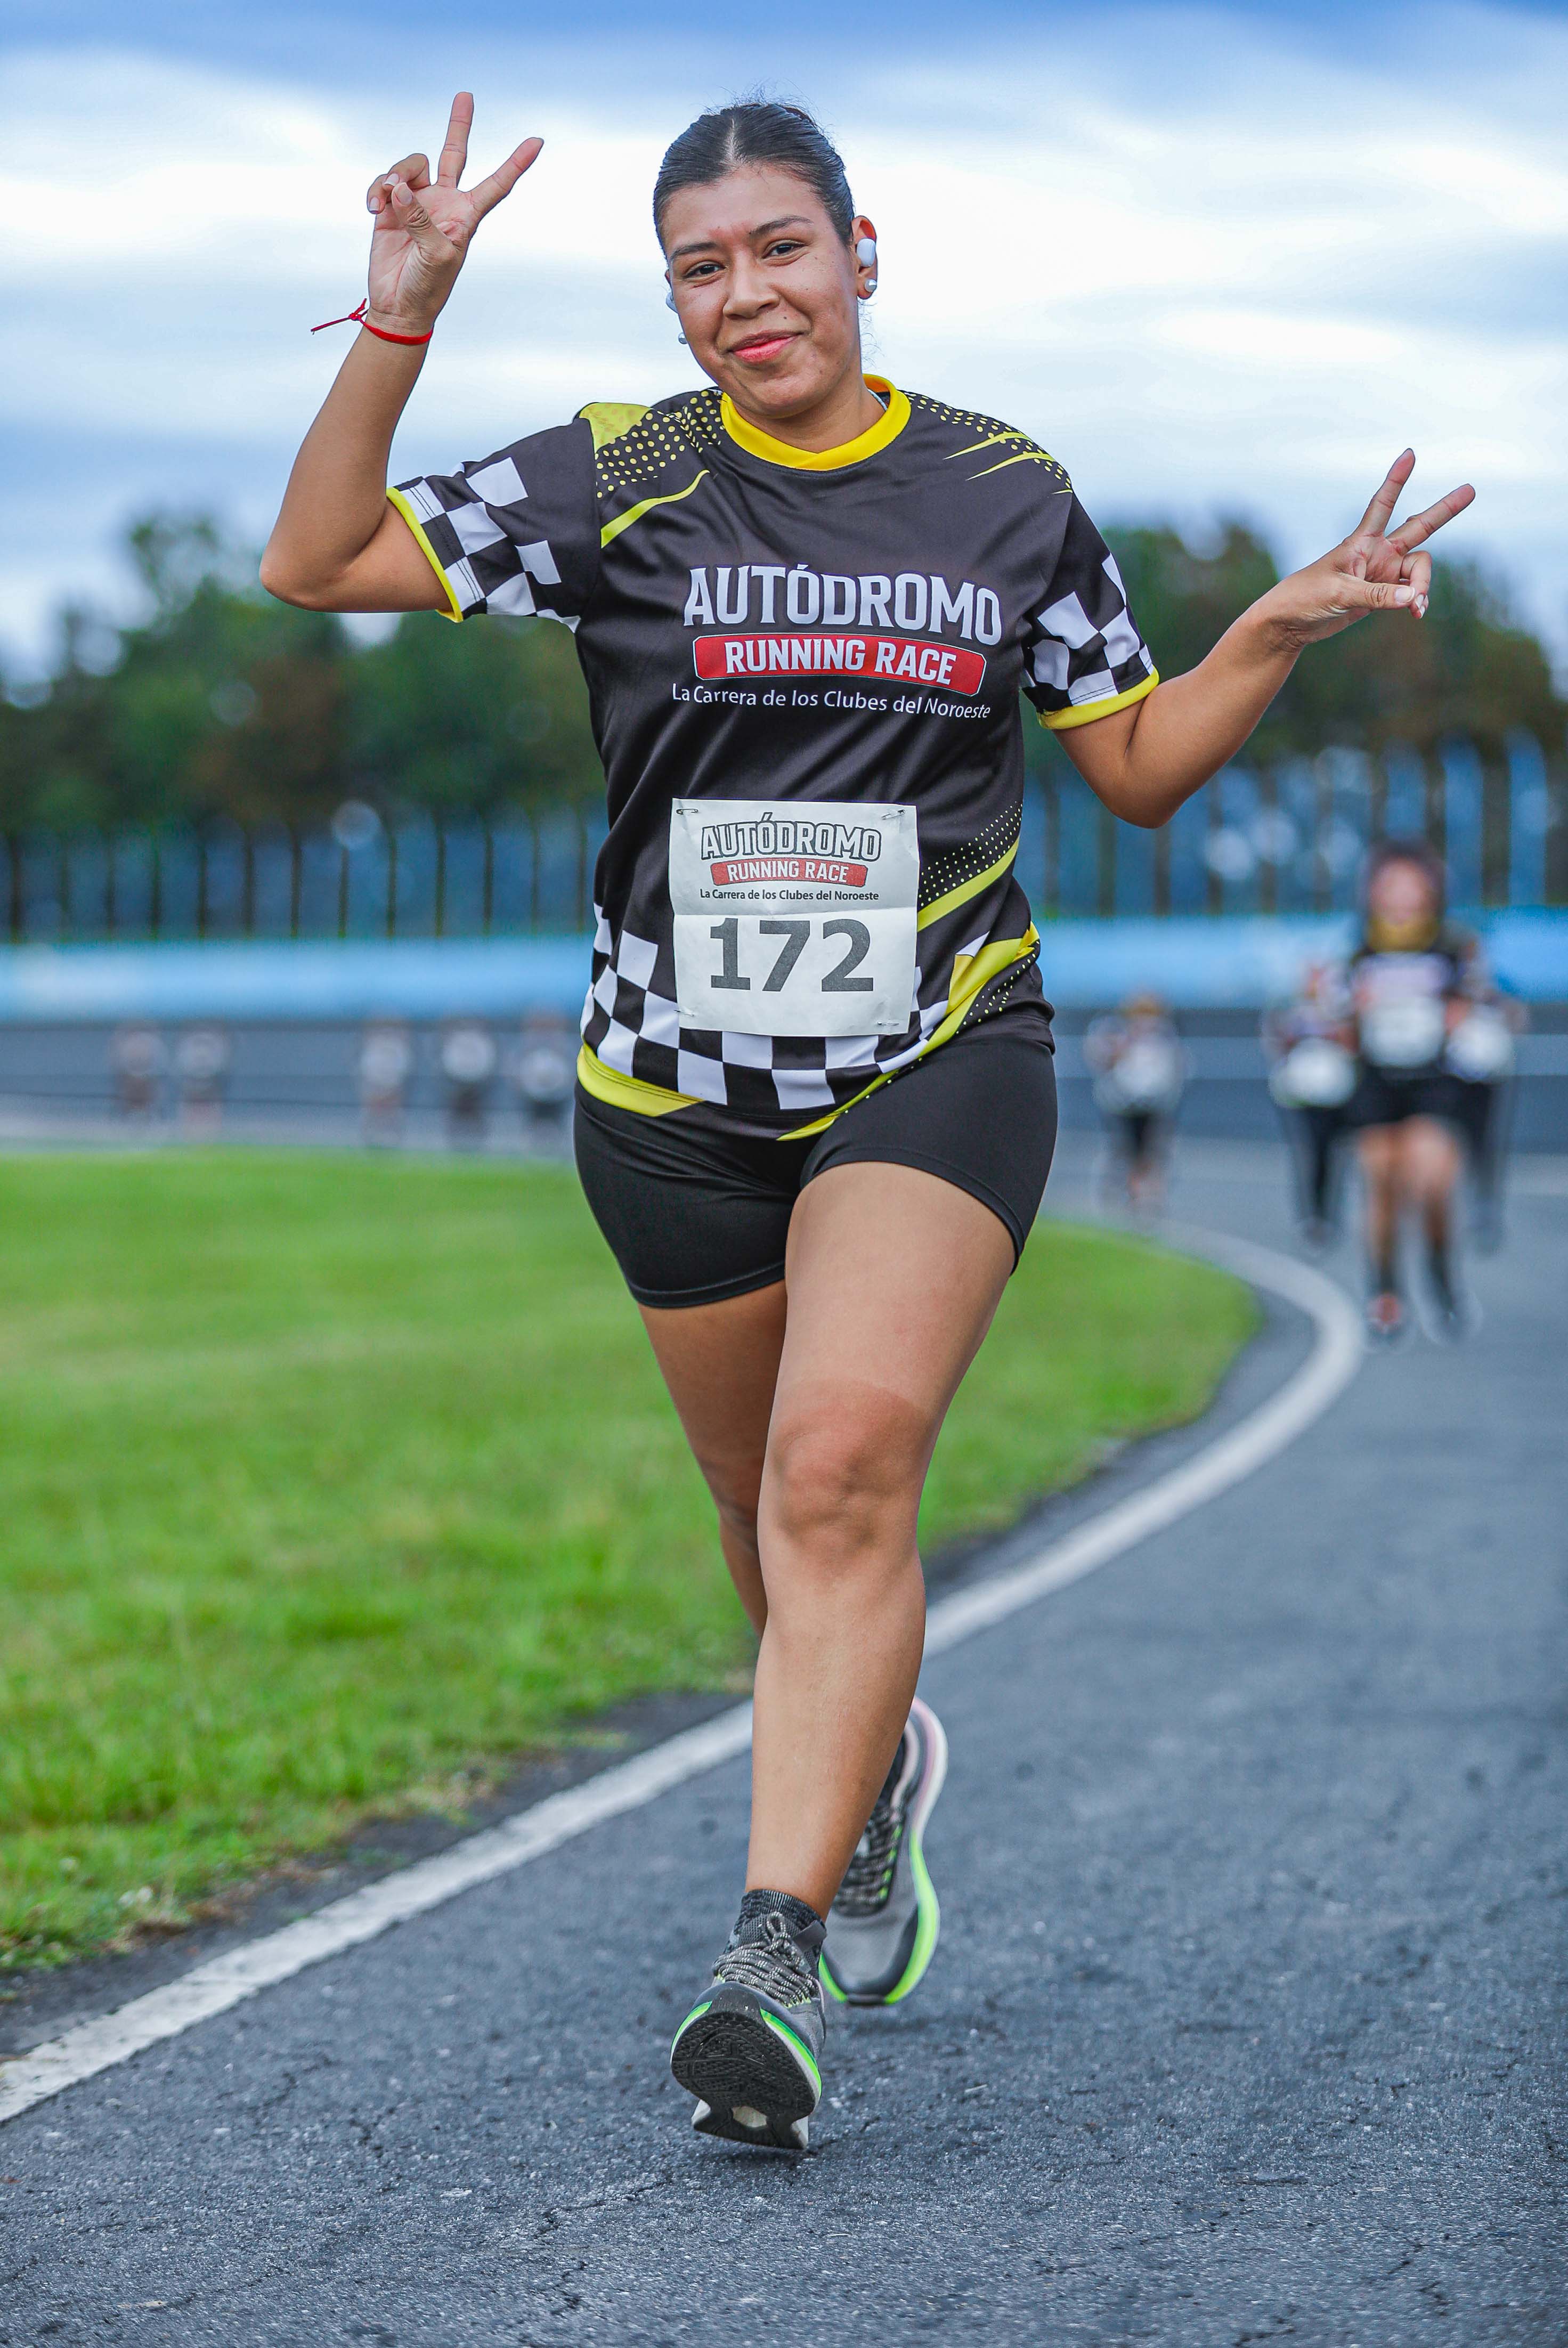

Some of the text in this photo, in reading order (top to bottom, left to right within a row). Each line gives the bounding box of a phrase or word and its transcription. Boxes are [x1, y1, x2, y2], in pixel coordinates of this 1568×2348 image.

[683, 563, 1002, 646] AUTÓDROMO
[725, 639, 957, 685] RUNNING RACE
[672, 683, 990, 719] La Carrera de los Clubes del Noroeste
[701, 812, 881, 862] AUTÓDROMO
[726, 860, 849, 883] RUNNING RACE
[700, 889, 879, 901] La Carrera de los Clubes del Noroeste
[710, 917, 874, 992] 172
